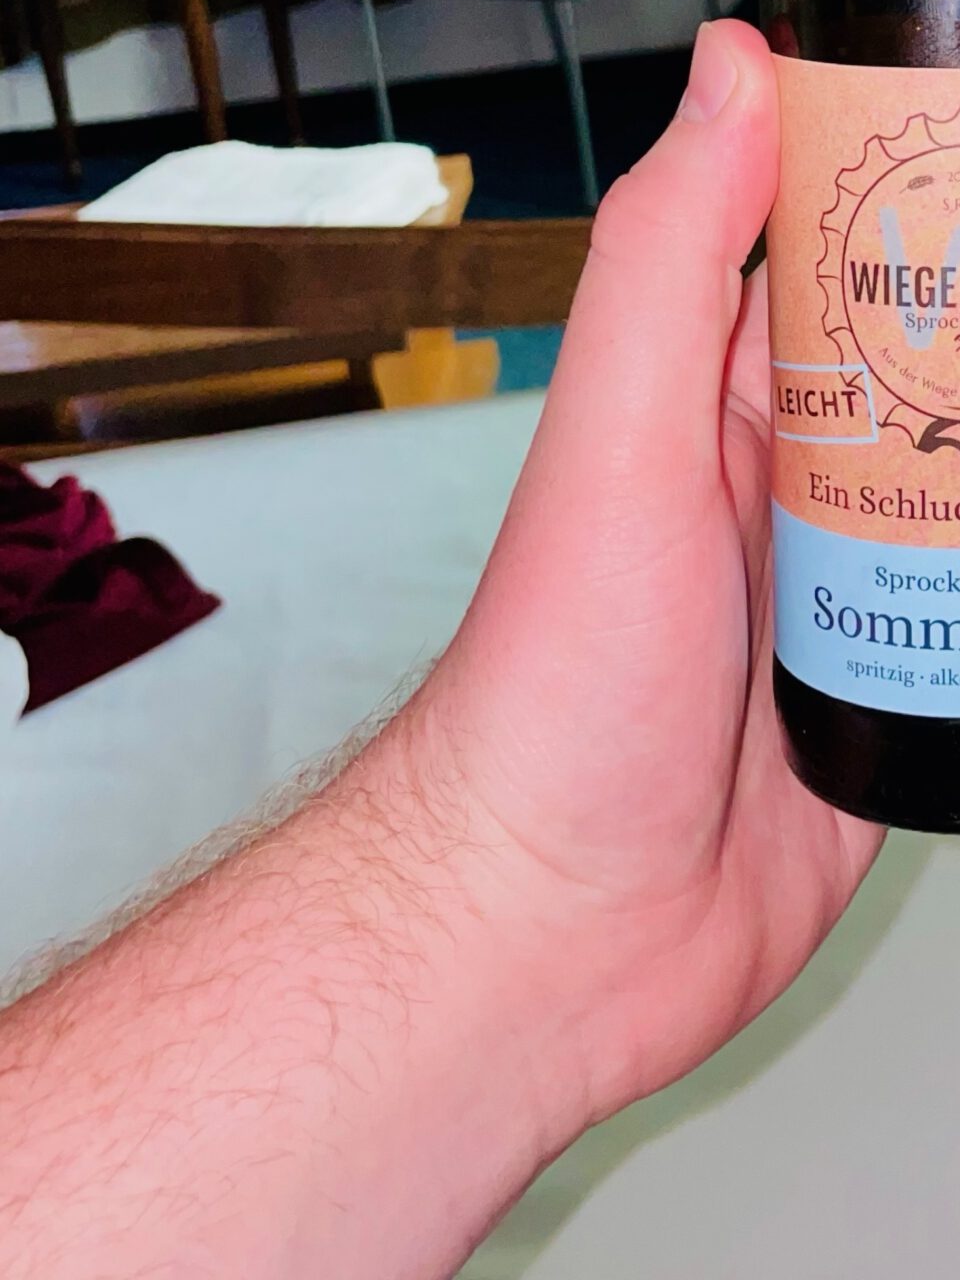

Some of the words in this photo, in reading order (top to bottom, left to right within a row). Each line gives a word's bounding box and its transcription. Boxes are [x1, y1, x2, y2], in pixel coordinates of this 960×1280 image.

[878, 347, 898, 369] Aus
[899, 367, 917, 383] der
[922, 377, 958, 398] Wiege
[778, 386, 857, 417] LEICHT
[808, 472, 850, 510] Ein
[846, 658, 915, 688] spritzig
